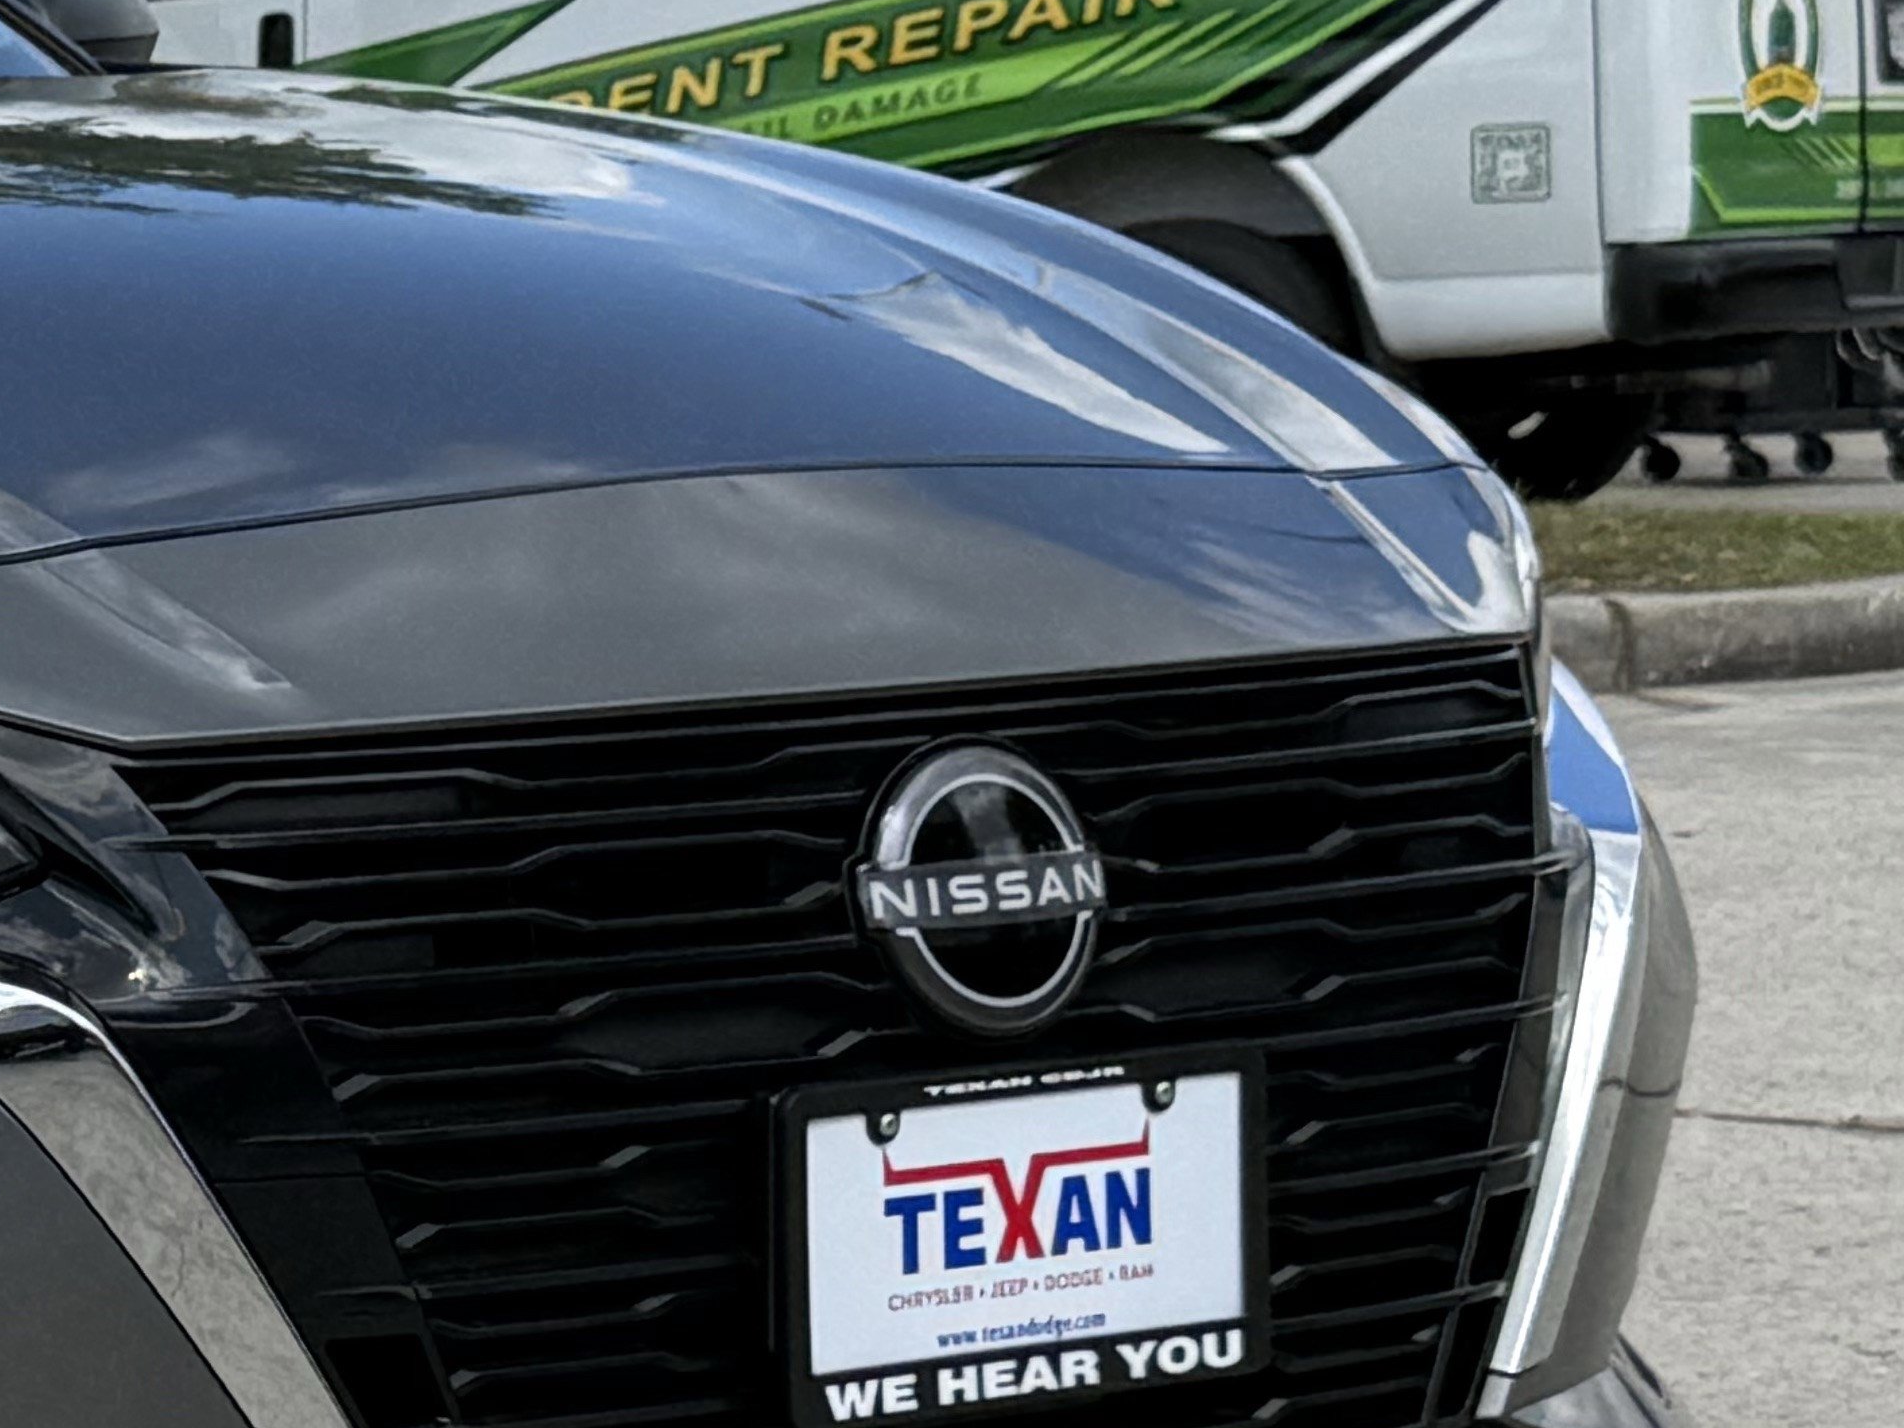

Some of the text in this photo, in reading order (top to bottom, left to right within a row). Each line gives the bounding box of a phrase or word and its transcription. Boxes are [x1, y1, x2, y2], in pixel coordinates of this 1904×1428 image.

[812, 72, 982, 131] DAMAGE
[868, 860, 1106, 921] NISSAN
[923, 1075, 1032, 1098] TEXAN
[883, 1138, 1153, 1276] TEXAN
[888, 1283, 974, 1312] CHRYSLER
[1045, 1267, 1104, 1292] DODGE
[825, 1329, 1244, 1422] WE HEAR YOU
